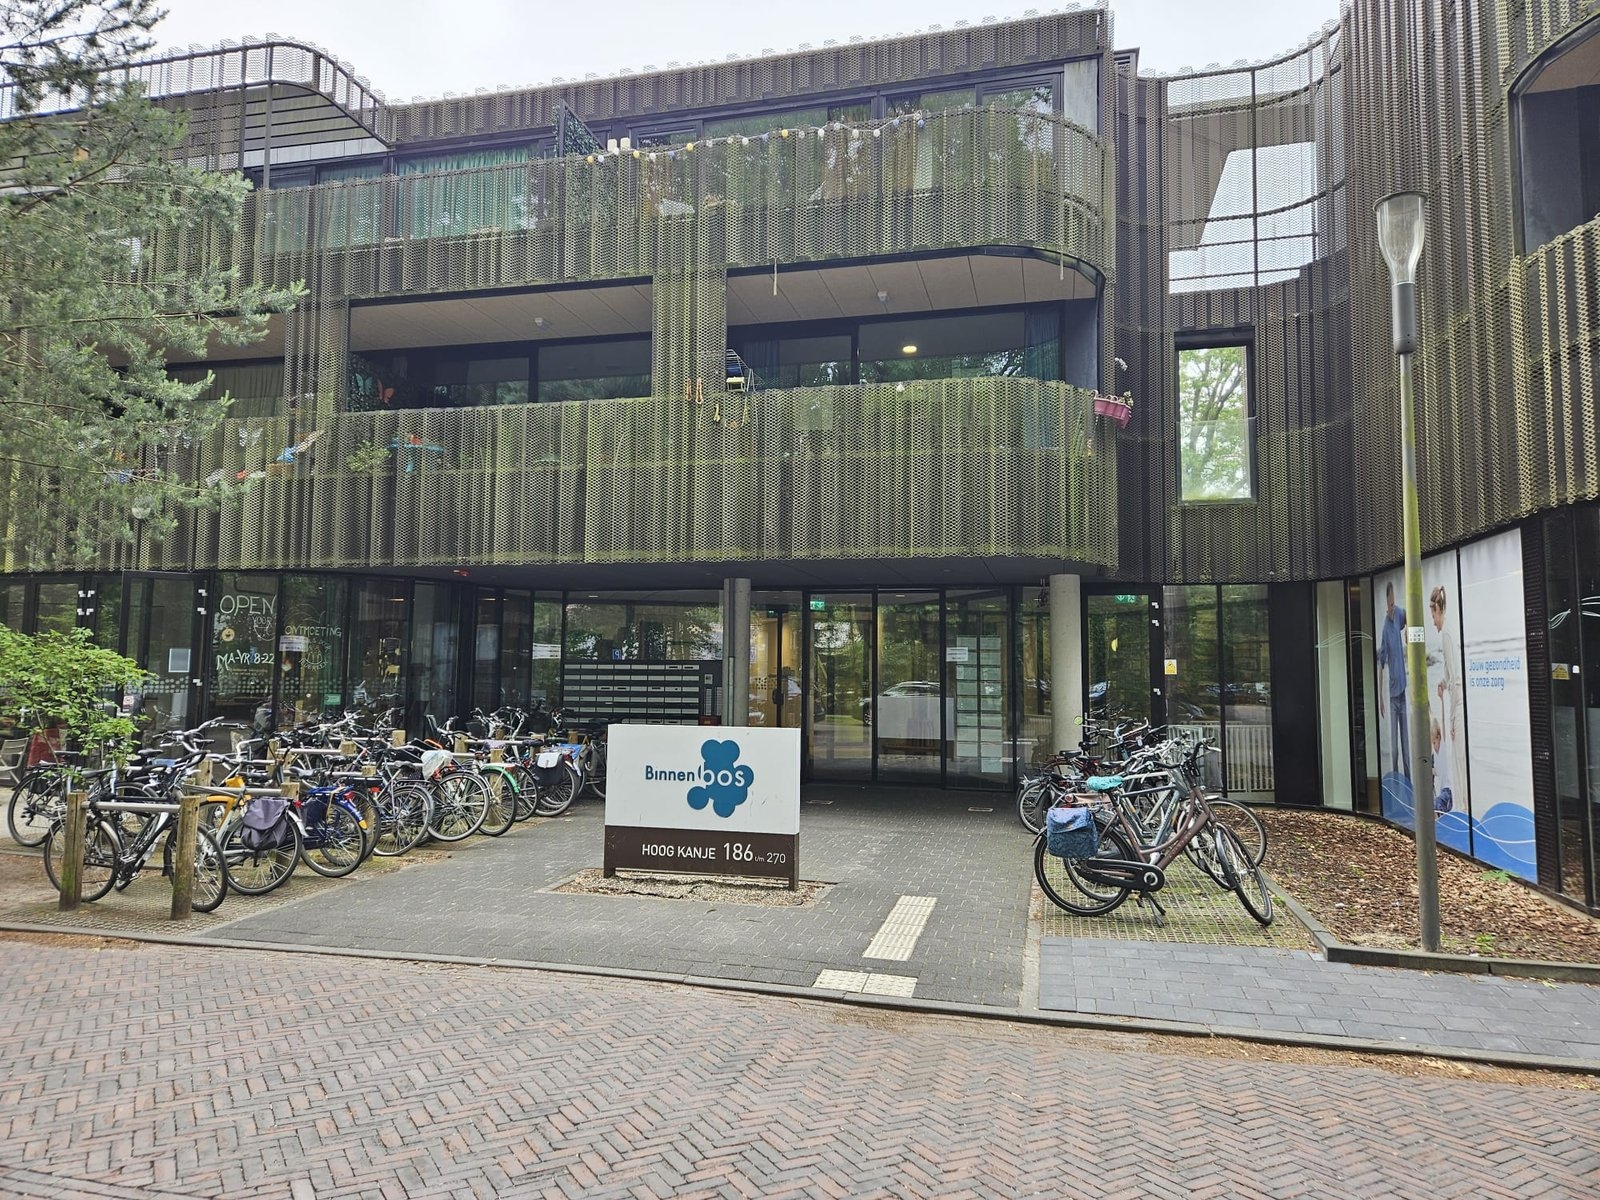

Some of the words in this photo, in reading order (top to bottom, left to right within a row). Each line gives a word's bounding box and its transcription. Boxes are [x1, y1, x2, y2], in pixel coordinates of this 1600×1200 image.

[219, 595, 276, 616] OPEN
[1469, 660, 1484, 671] Jouw
[1485, 657, 1520, 673] gezondheid
[1475, 677, 1489, 687] onze
[1490, 677, 1504, 690] zorg
[642, 844, 674, 856] HOOG
[677, 846, 716, 859] KANJE
[723, 842, 753, 861] 186
[766, 852, 786, 864] 270
